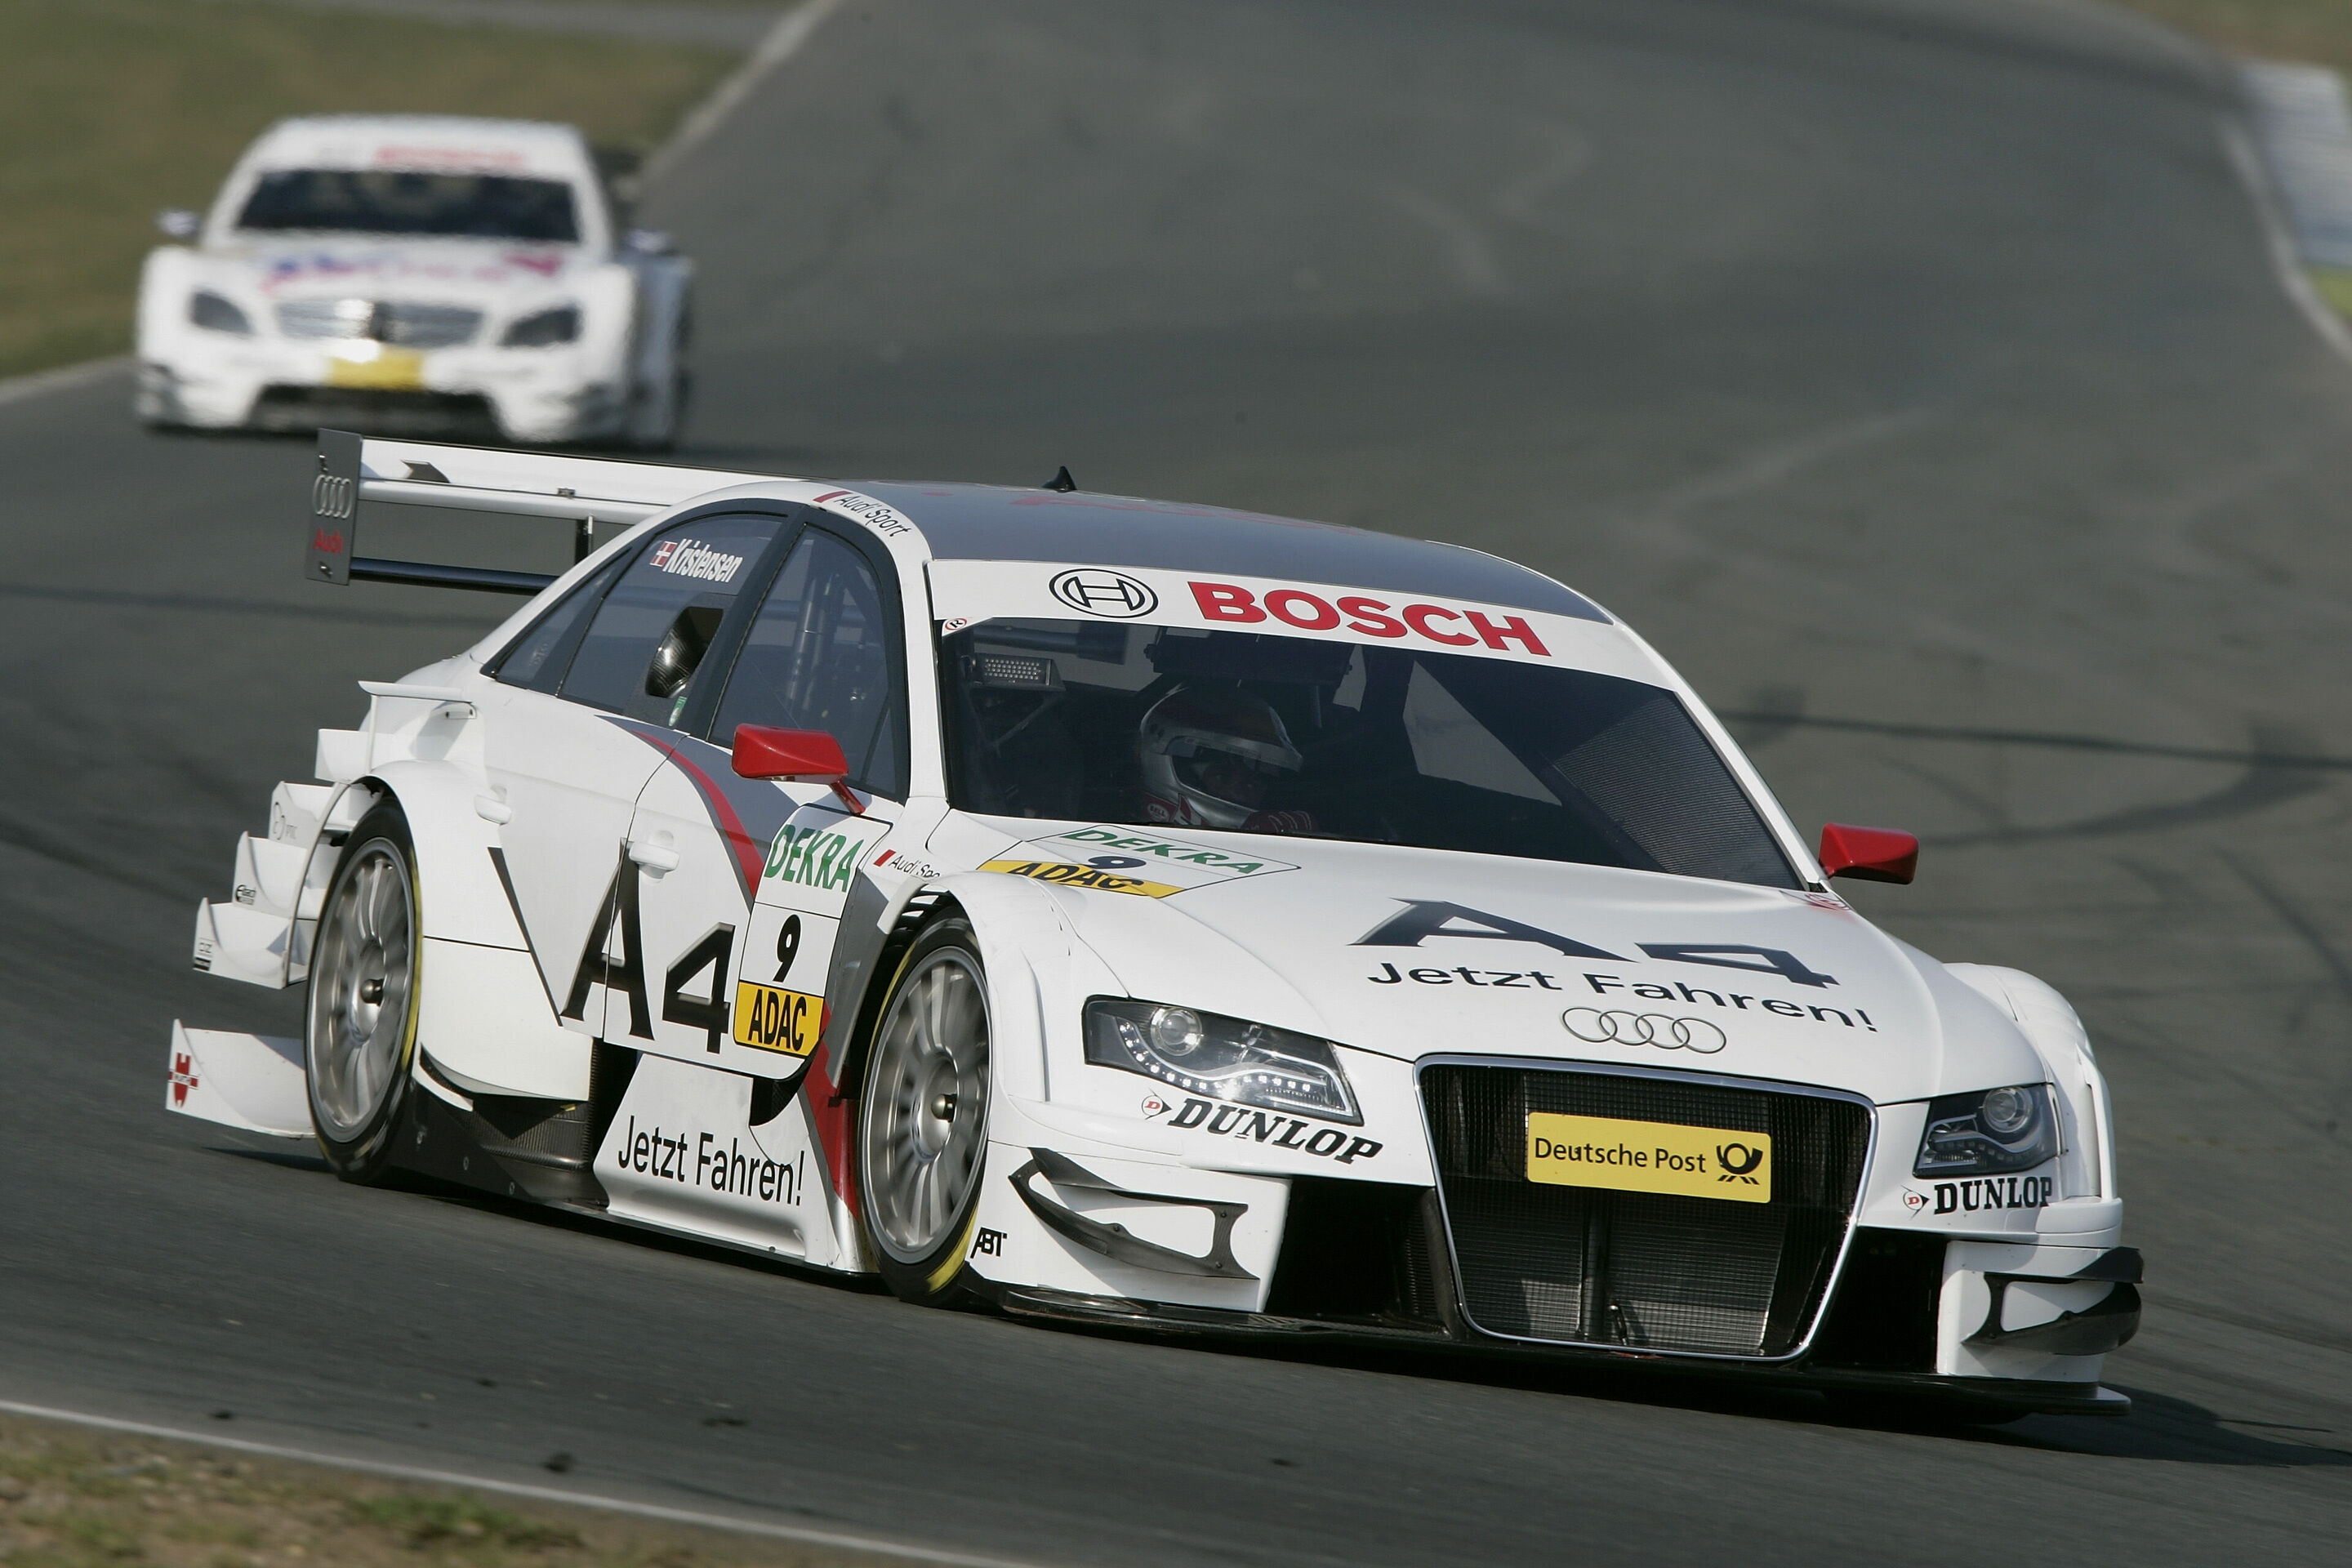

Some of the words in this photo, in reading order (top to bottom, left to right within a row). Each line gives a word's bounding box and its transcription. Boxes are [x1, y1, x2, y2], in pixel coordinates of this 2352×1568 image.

[834, 496, 881, 514] Audi
[865, 509, 911, 537] Sport
[312, 527, 344, 554] Audi
[662, 538, 743, 582] Kristensen
[1187, 581, 1552, 657] BOSCH
[764, 824, 864, 893] DEKRA
[889, 854, 921, 875] Audi
[1059, 830, 1264, 875] DEKRA
[1088, 855, 1147, 869] 9
[1006, 862, 1145, 889] ADAC
[560, 836, 735, 1054] A4
[773, 914, 801, 982] 9
[1346, 898, 1841, 989] A4
[747, 989, 807, 1051] ADAC
[1367, 962, 1562, 991] Jetzt
[1581, 972, 1878, 1033] Fahren!
[1167, 1098, 1383, 1165] DUNLOP
[618, 1115, 688, 1183] Jetzt
[696, 1131, 804, 1206] Fahren!
[1535, 1137, 1648, 1167] Deutsche
[1655, 1147, 1706, 1174] Post
[1934, 1176, 2052, 1215] DUNLOP
[970, 1227, 1008, 1258] ABT
